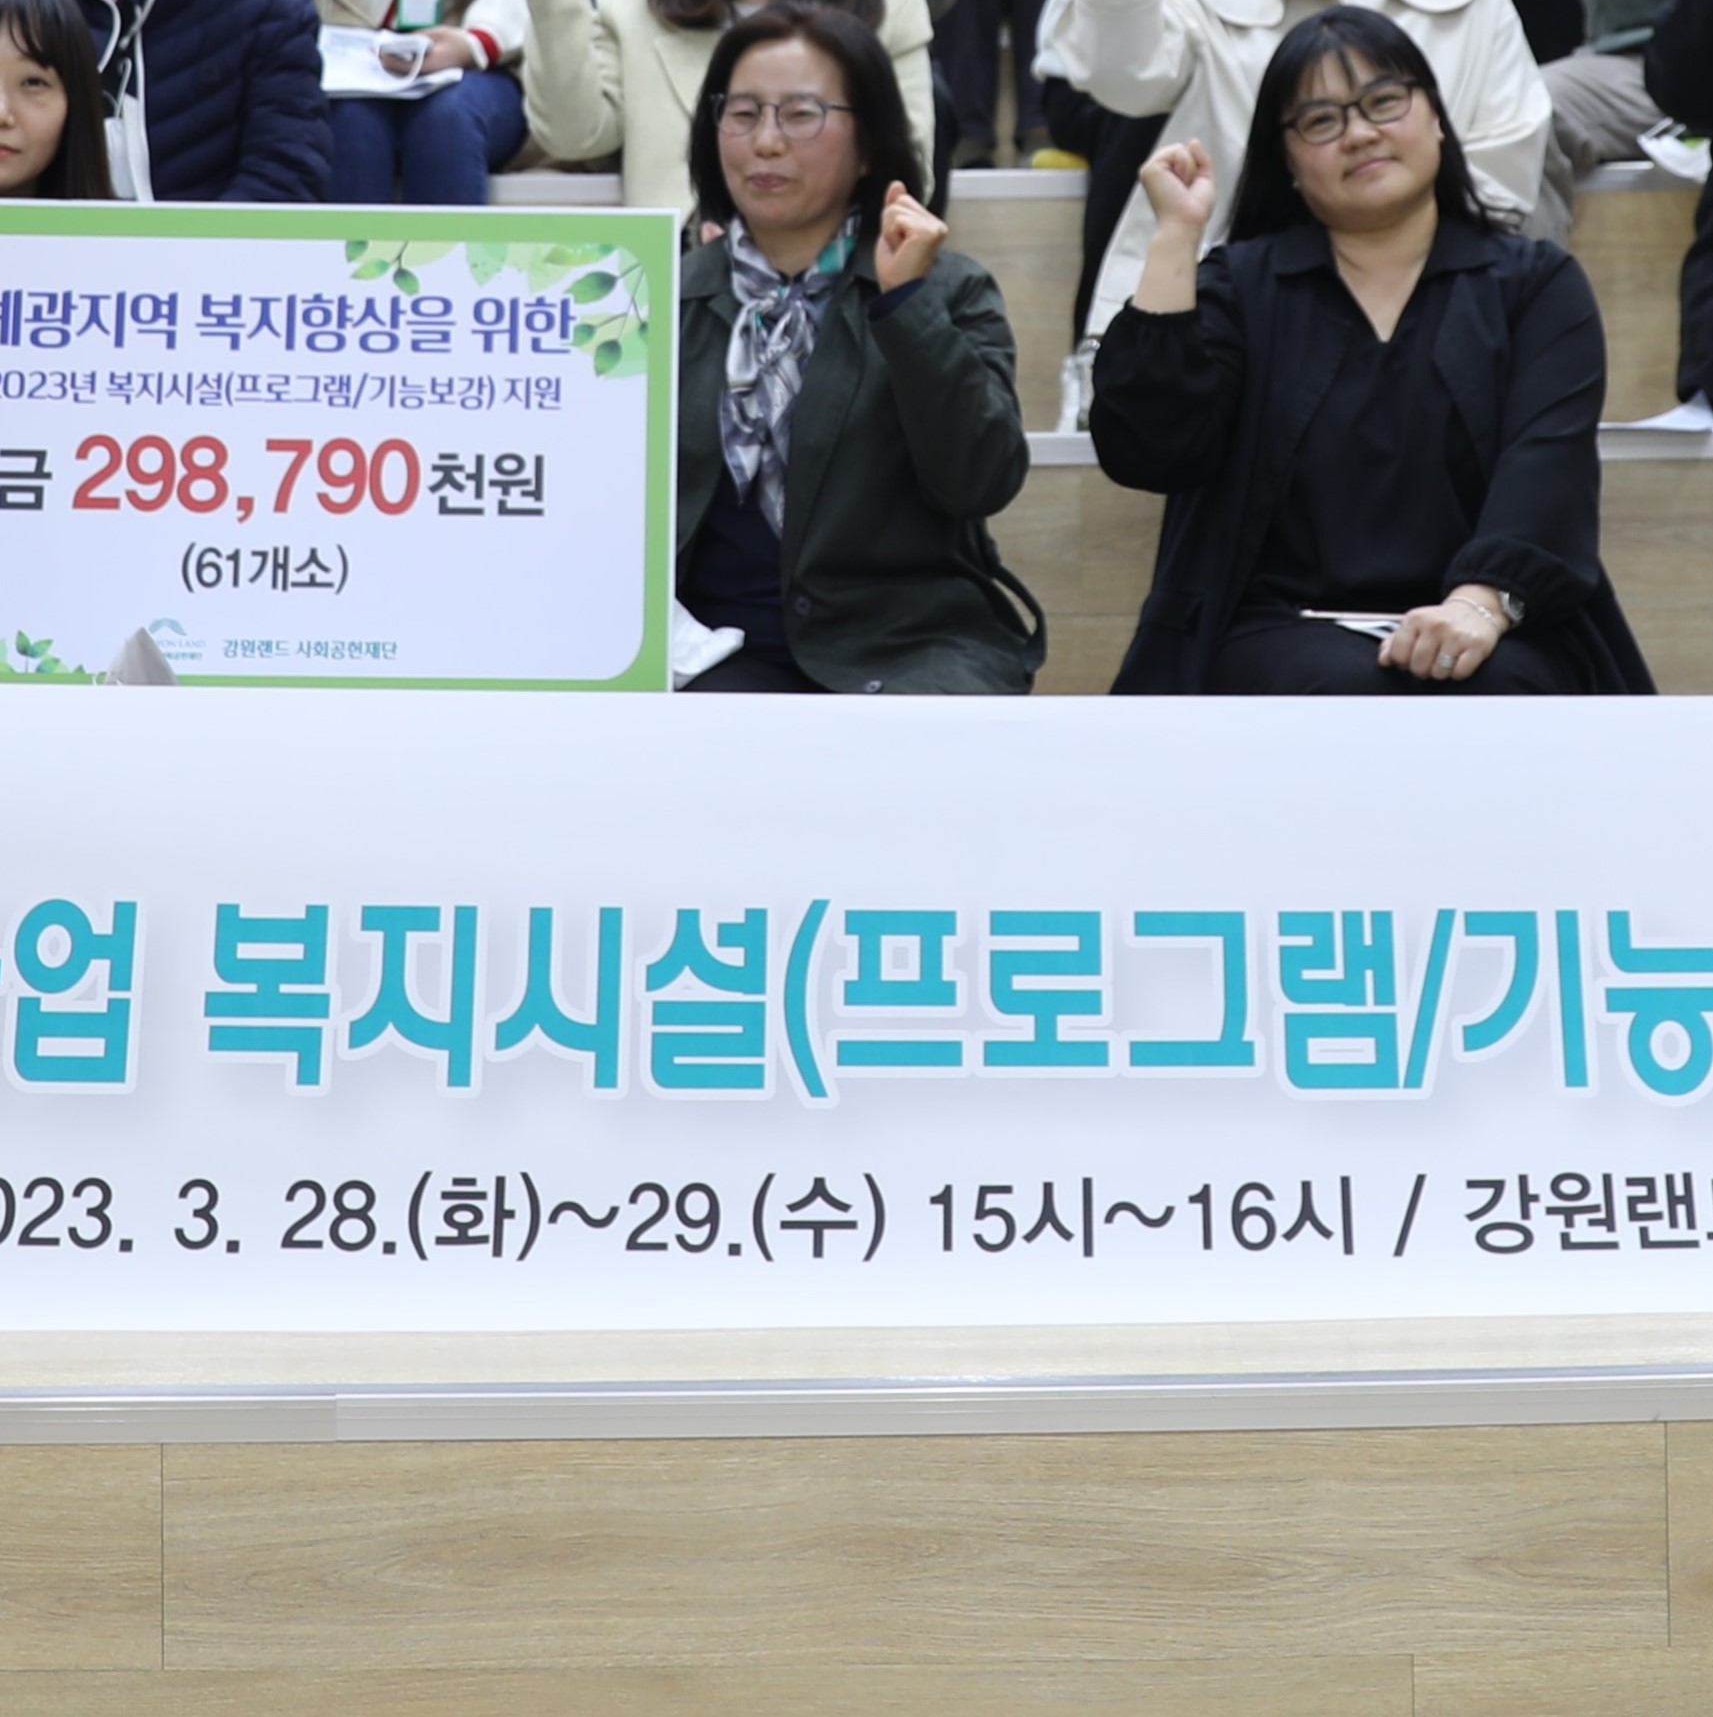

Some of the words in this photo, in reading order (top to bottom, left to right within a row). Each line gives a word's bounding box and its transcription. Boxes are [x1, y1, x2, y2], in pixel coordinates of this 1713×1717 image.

[195, 294, 457, 355] 복지향상을
[471, 296, 577, 355] 위한
[106, 371, 497, 411] 복지시설(프로그램/기능보강)
[504, 376, 563, 411] 지원
[180, 542, 350, 595] (61개소)
[223, 639, 289, 659] 강원랜드
[296, 640, 398, 661] 사회공헌재단
[173, 1177, 242, 1255] 3.
[928, 1175, 1356, 1259] 15시~16시
